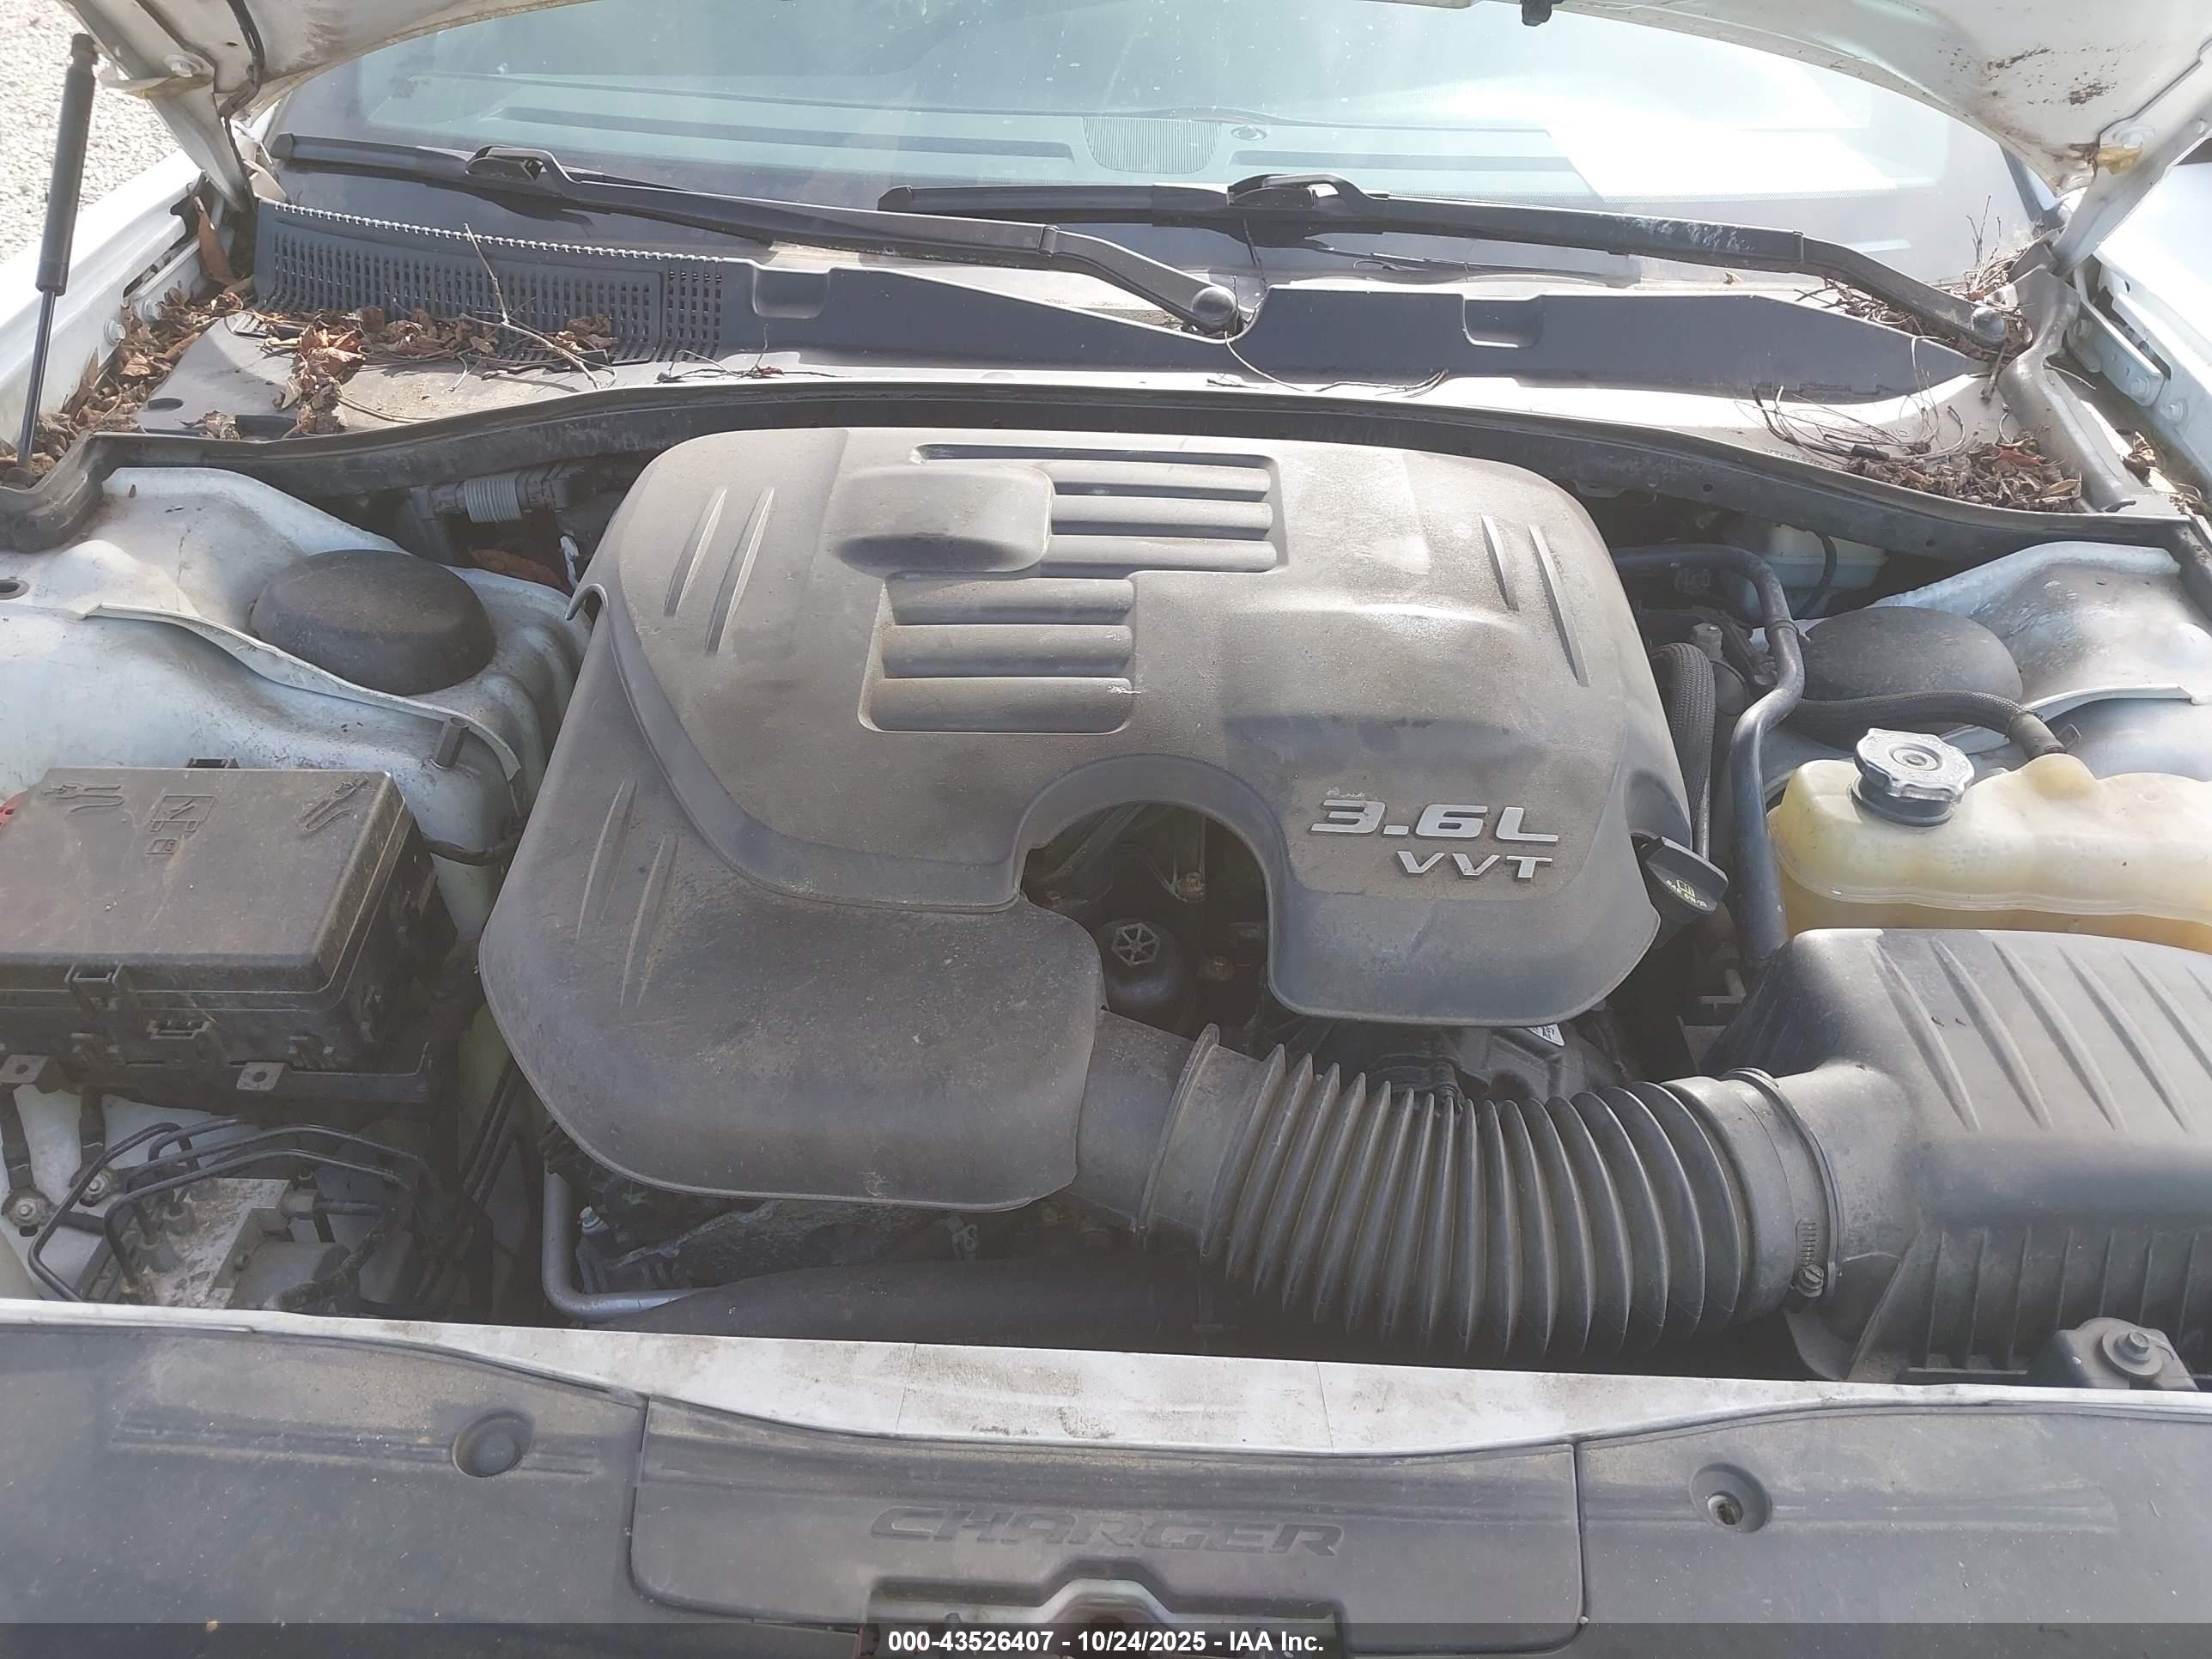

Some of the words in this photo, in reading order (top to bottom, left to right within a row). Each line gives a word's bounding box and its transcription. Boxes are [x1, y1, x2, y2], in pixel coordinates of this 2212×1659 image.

[1310, 799, 1559, 843] 3.6L
[1397, 851, 1553, 879] VVT
[871, 1507, 1345, 1556] CHARGER
